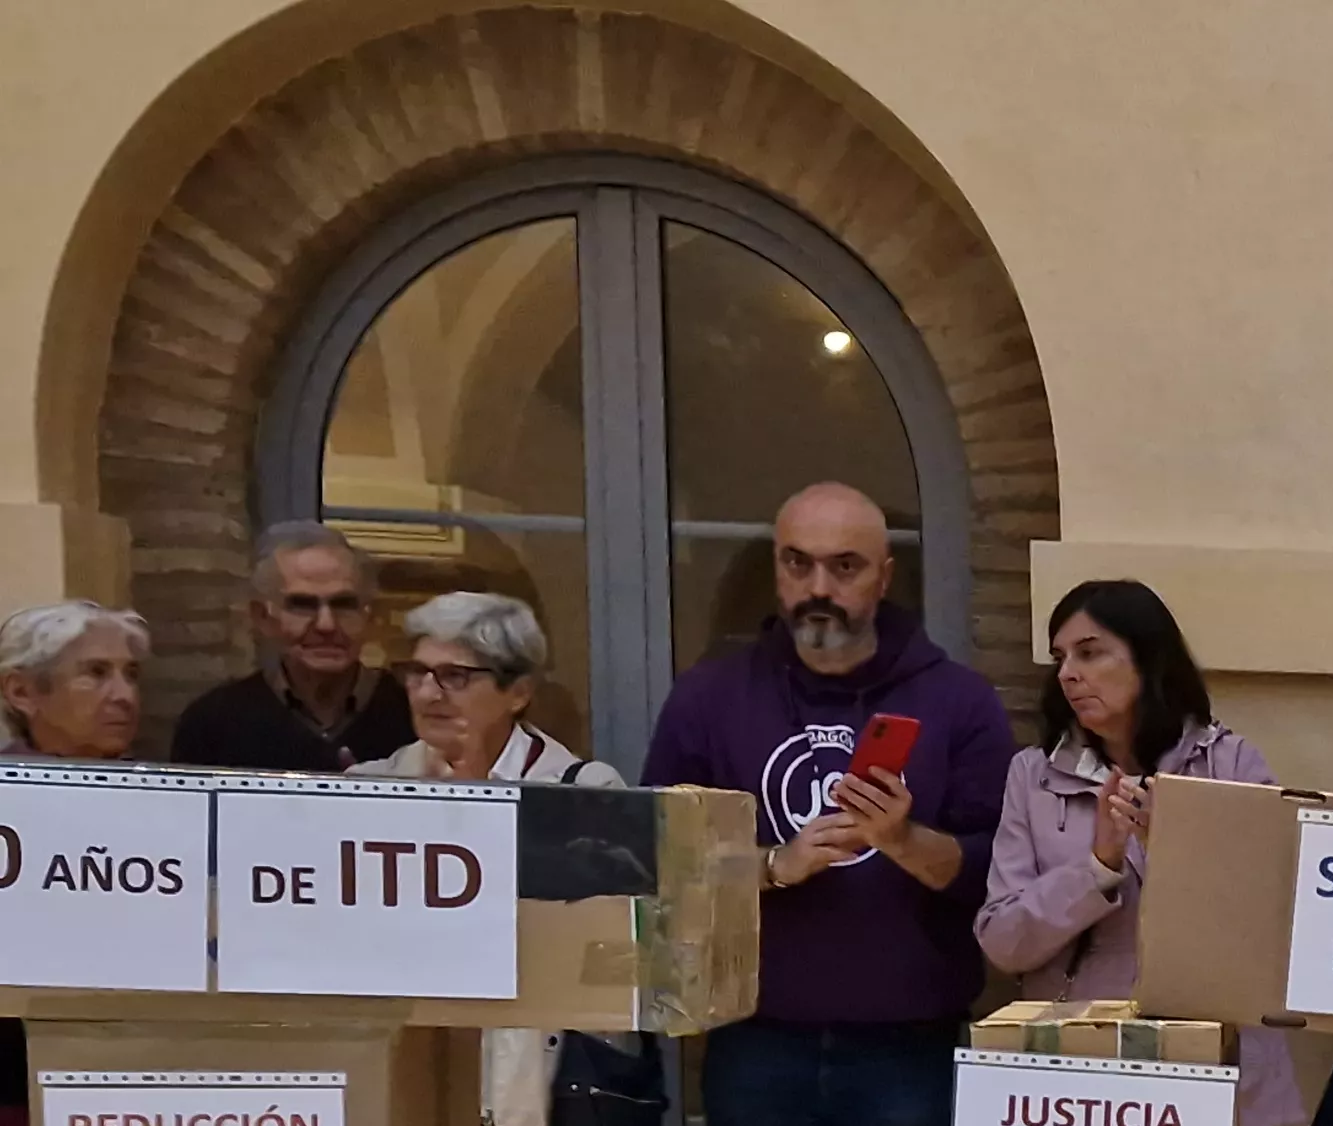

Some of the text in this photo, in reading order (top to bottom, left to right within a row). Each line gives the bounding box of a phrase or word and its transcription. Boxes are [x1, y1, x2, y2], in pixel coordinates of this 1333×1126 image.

[42, 846, 184, 895] AÑOS
[251, 865, 317, 905] DE
[340, 840, 482, 909] ITD
